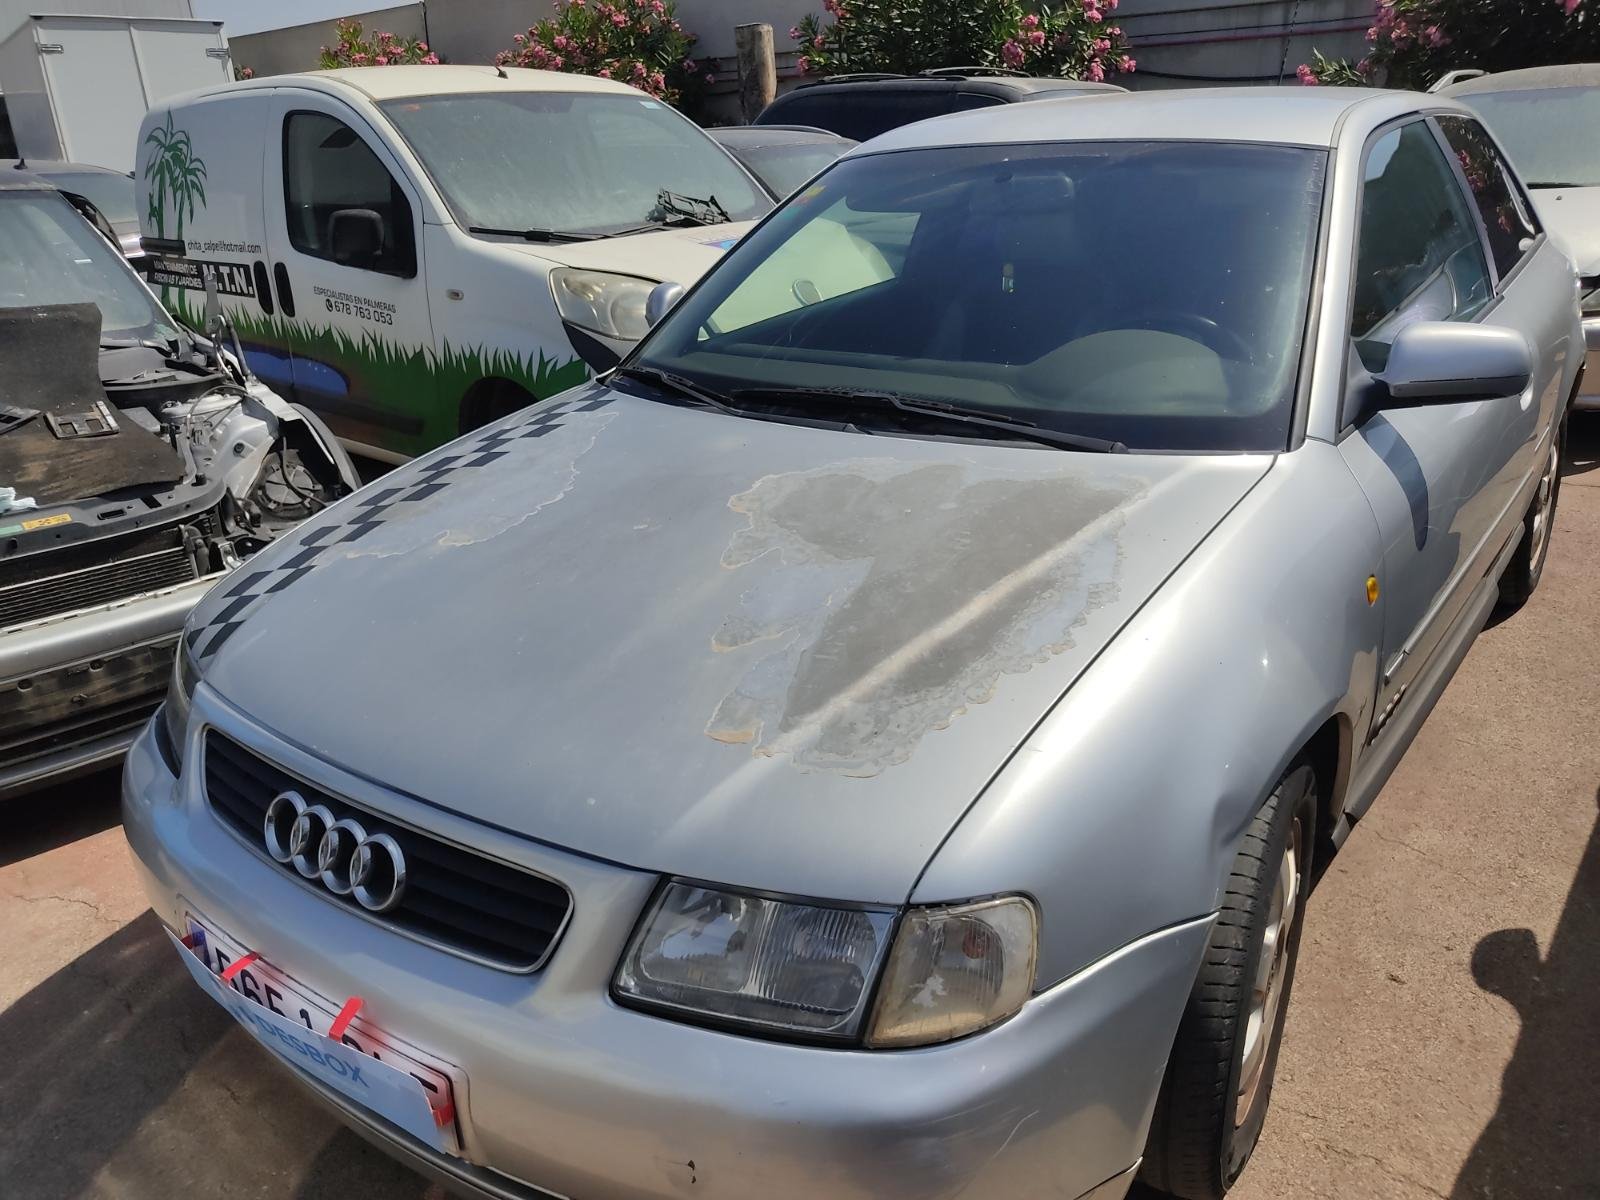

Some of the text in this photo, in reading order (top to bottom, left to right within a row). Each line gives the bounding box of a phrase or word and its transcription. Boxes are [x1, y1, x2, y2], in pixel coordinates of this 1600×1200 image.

[313, 286, 397, 313] ESPECIALISTAS EN PALMERAS
[334, 301, 393, 325] 678 763 053
